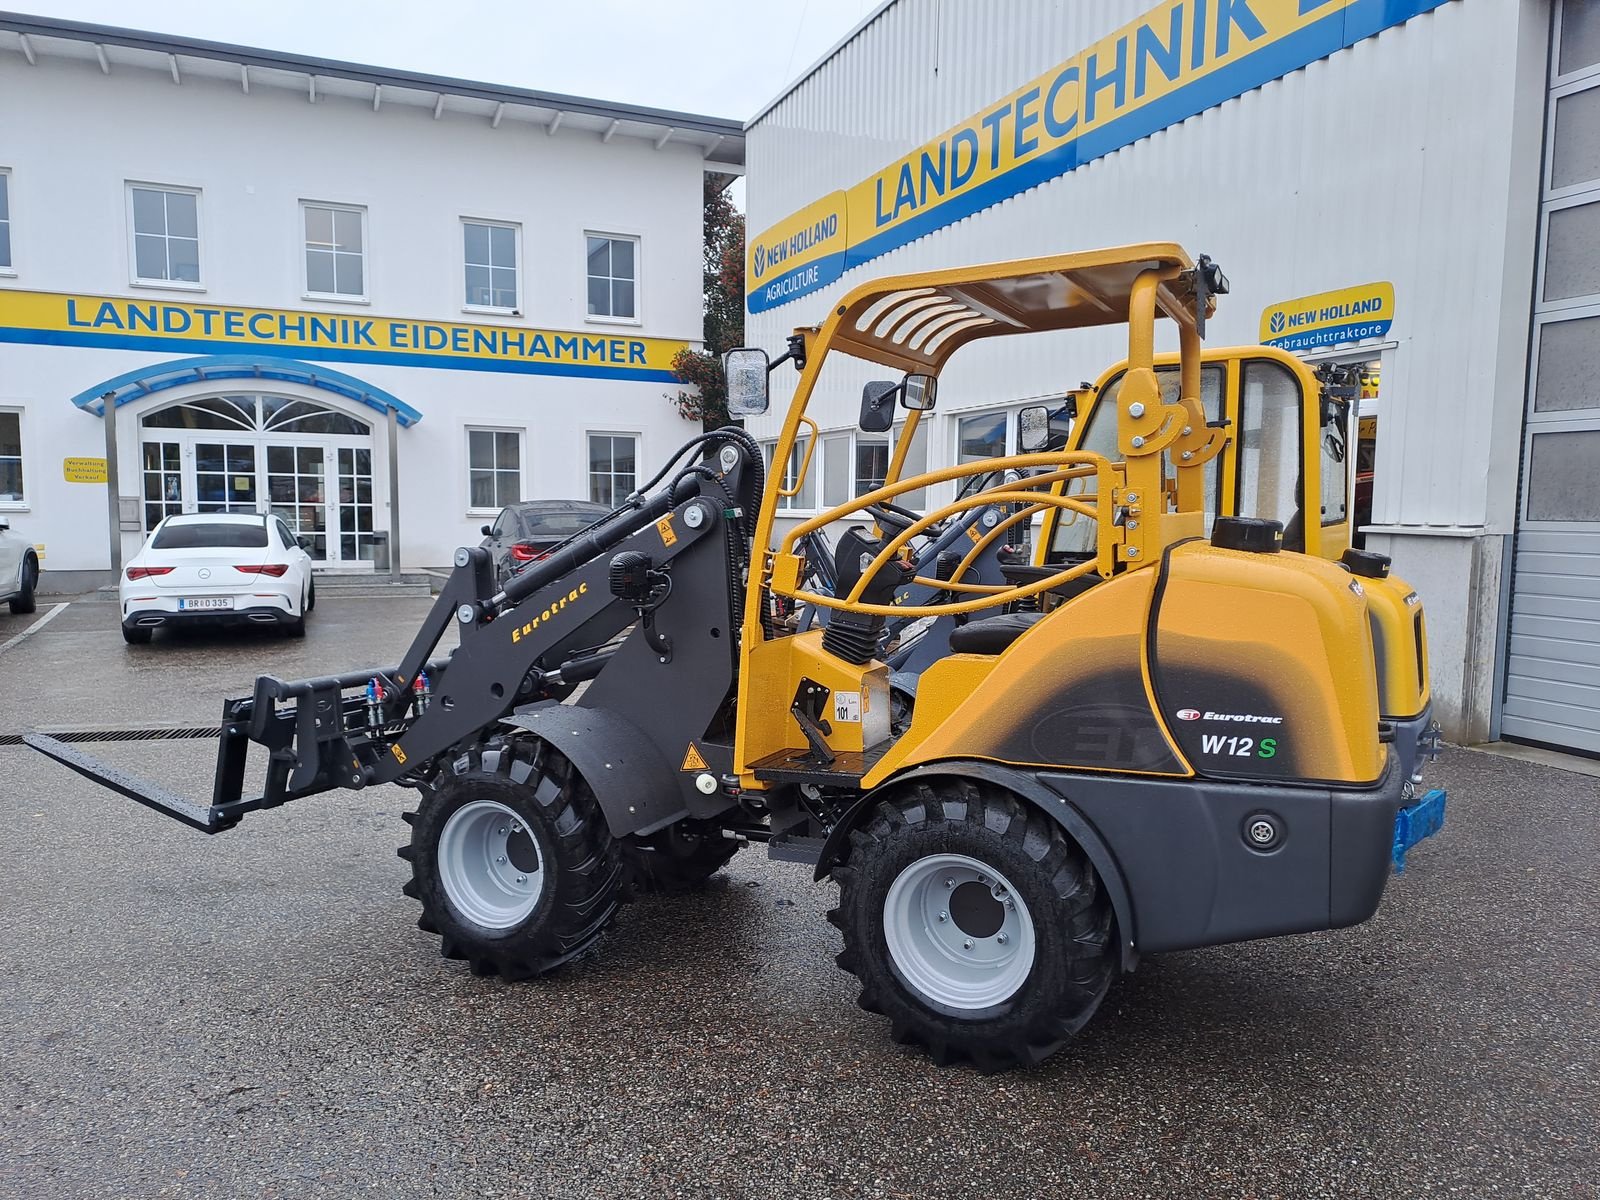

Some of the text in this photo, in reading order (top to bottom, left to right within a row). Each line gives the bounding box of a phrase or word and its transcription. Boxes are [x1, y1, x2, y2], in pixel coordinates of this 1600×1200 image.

[876, 0, 1267, 227] LANDTECHNIK
[767, 213, 837, 268] NEW HOLLAND
[766, 265, 819, 302] AGRICULTURE
[1288, 297, 1383, 328] NEW HOLLAND
[67, 299, 647, 364] LANDTECHNIK EIDENHAMMER
[511, 582, 588, 643] Eurotrac
[836, 706, 848, 720] 101
[1203, 711, 1283, 724] Eurotrac
[1201, 734, 1277, 758] W12 S
